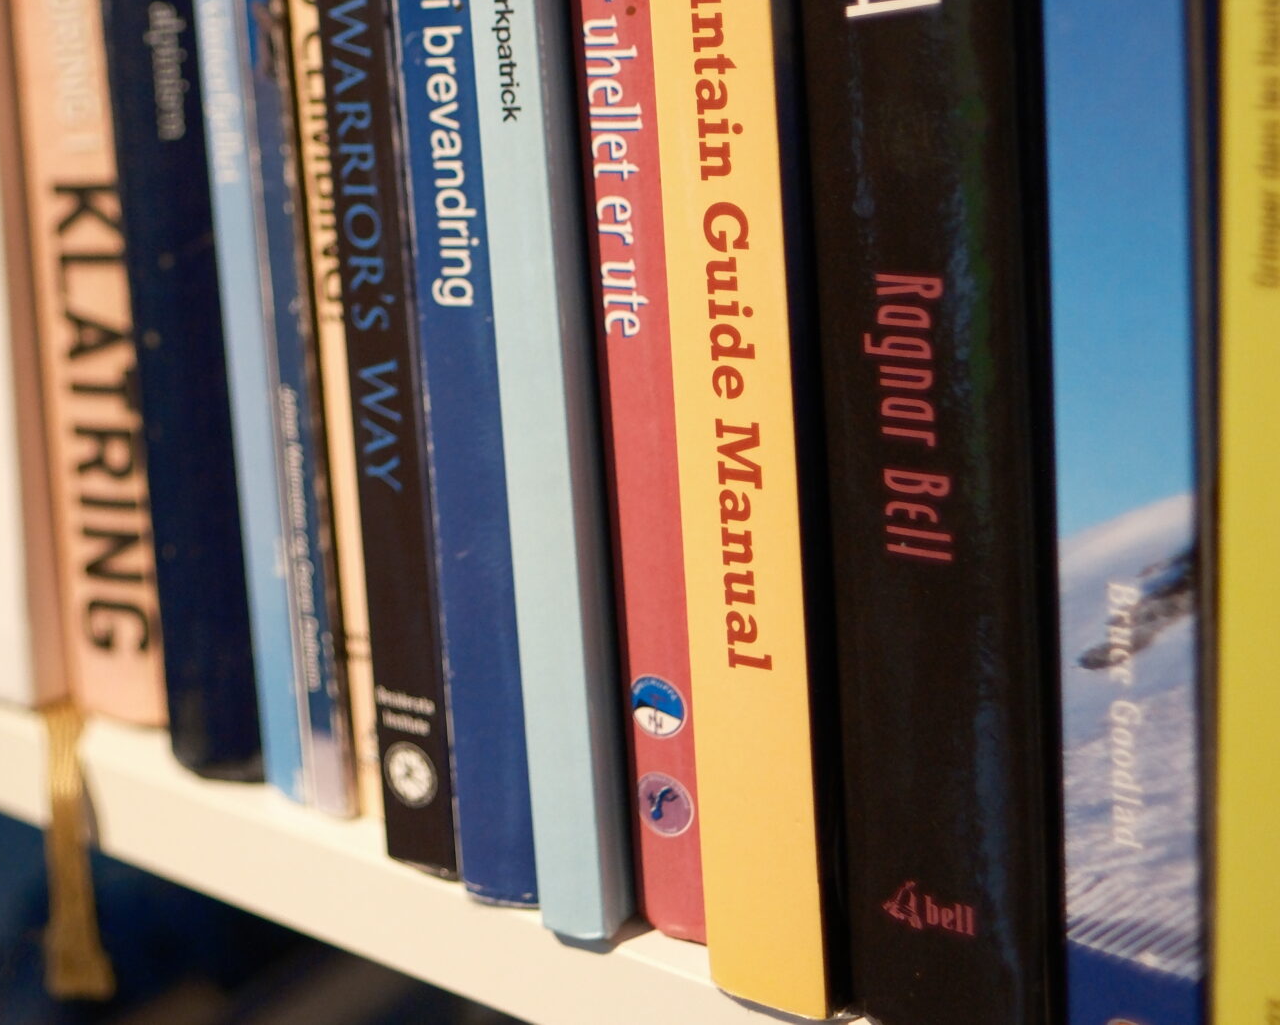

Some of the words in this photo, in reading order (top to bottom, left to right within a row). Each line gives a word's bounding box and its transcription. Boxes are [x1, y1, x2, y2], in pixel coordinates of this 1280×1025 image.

[143, 0, 191, 142] alpinism
[582, 13, 645, 182] uhellet
[420, 24, 481, 308] brevandring
[595, 193, 636, 247] er
[601, 258, 650, 339] ute
[702, 201, 756, 401] Guide
[863, 273, 944, 448] Ragnar
[50, 179, 153, 660] KLATRING
[357, 357, 403, 493] WAY
[714, 417, 773, 672] Manual
[1106, 582, 1140, 686] Bruce
[1109, 699, 1145, 851] Goodlad
